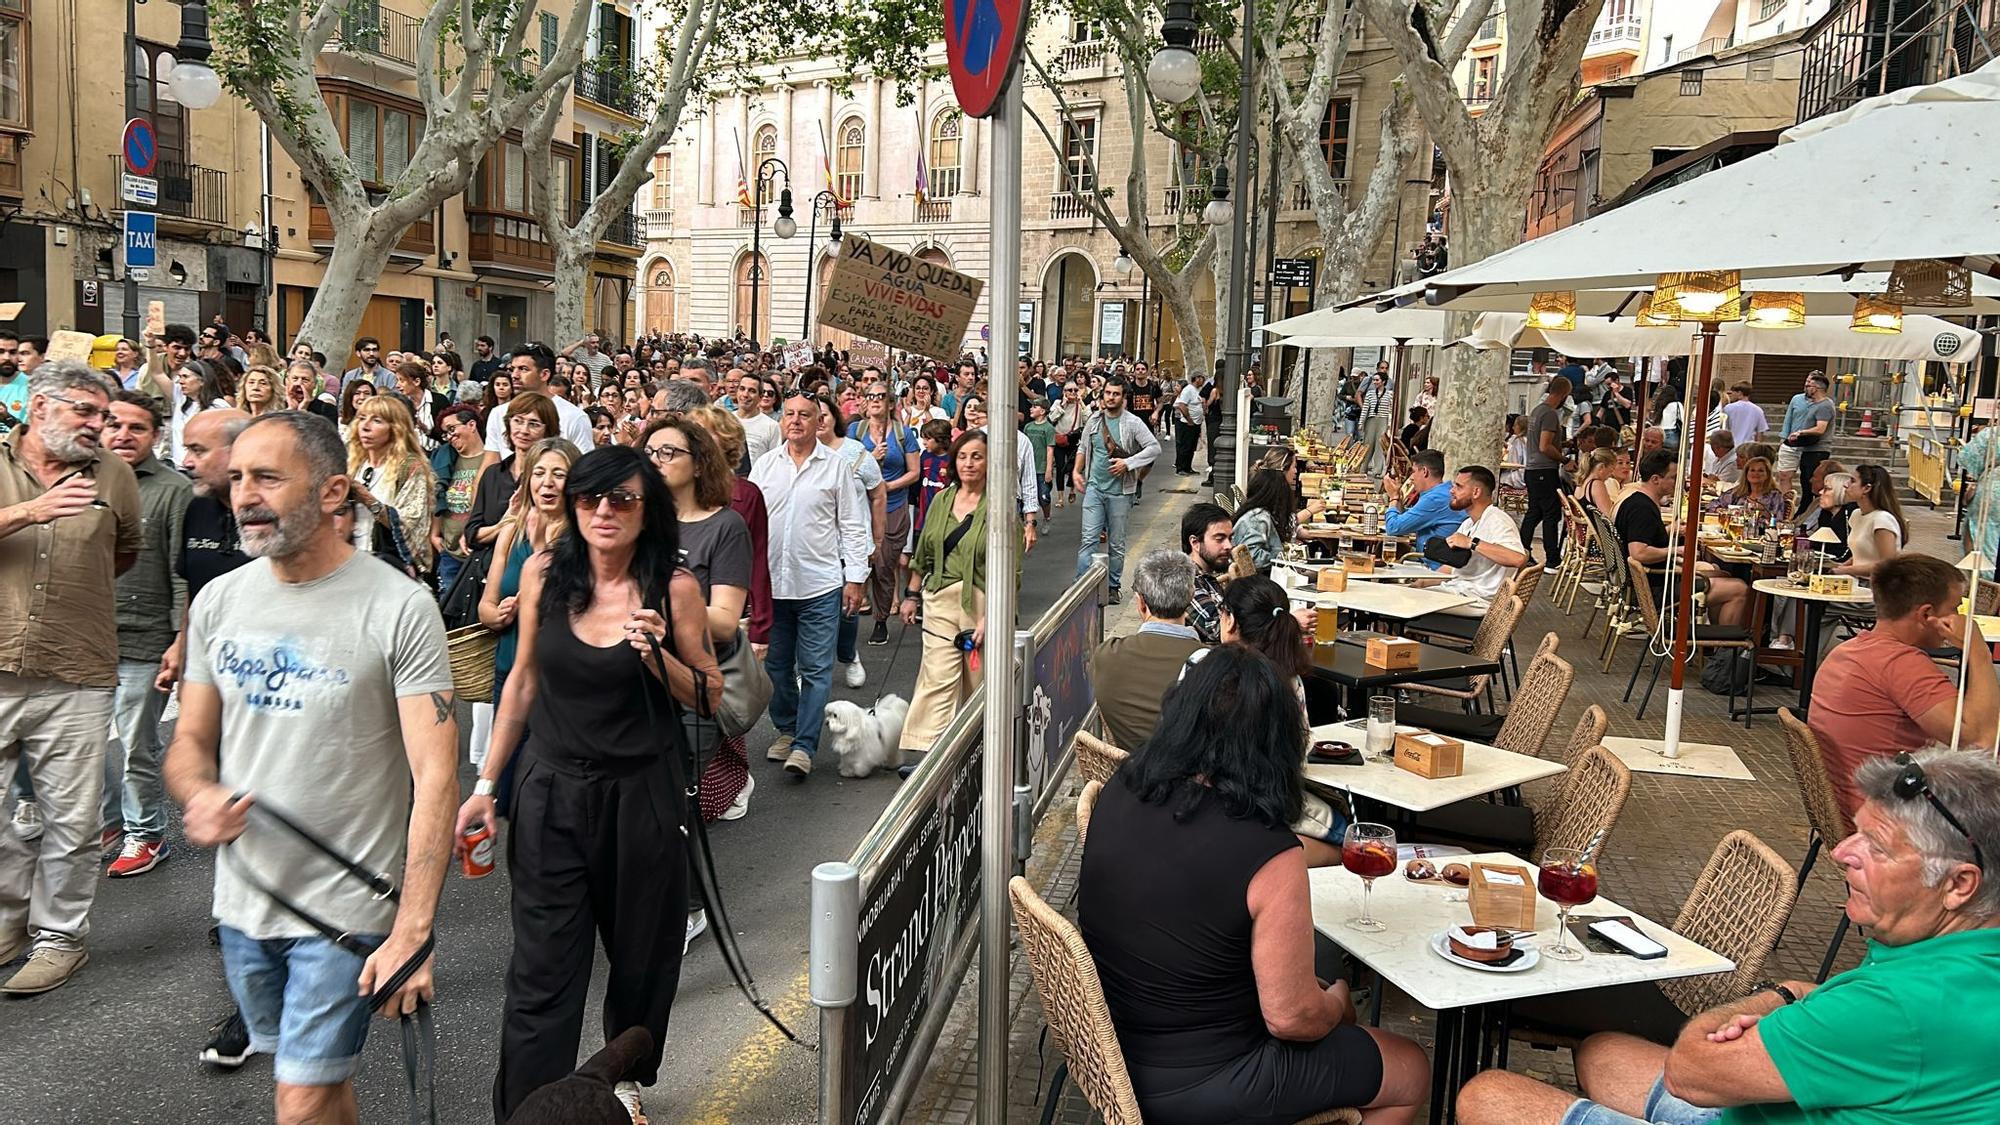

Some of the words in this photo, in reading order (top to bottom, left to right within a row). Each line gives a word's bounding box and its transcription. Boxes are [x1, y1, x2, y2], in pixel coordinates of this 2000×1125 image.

[127, 231, 155, 249] TAXI
[849, 238, 874, 265] YA
[877, 250, 912, 273] NO
[915, 262, 974, 299] QUEDA
[880, 272, 926, 296] AGUA
[831, 288, 897, 315] ESPACIOS
[904, 310, 952, 334] VITALES
[864, 279, 947, 319] VIVIENDAS
[829, 312, 837, 322] Y
[837, 314, 857, 328] SUS
[863, 320, 928, 351] HABITANTES
[848, 306, 876, 319] PARA
[883, 315, 930, 337] MALLORCA
[851, 341, 885, 352] ESTIMAM
[216, 639, 267, 687] Pepe
[857, 866, 901, 943] NMOBILIARIA
[905, 837, 920, 871] REAL
[920, 807, 939, 848] ESTATE
[865, 864, 931, 1052] Strand
[933, 793, 983, 916] Propert
